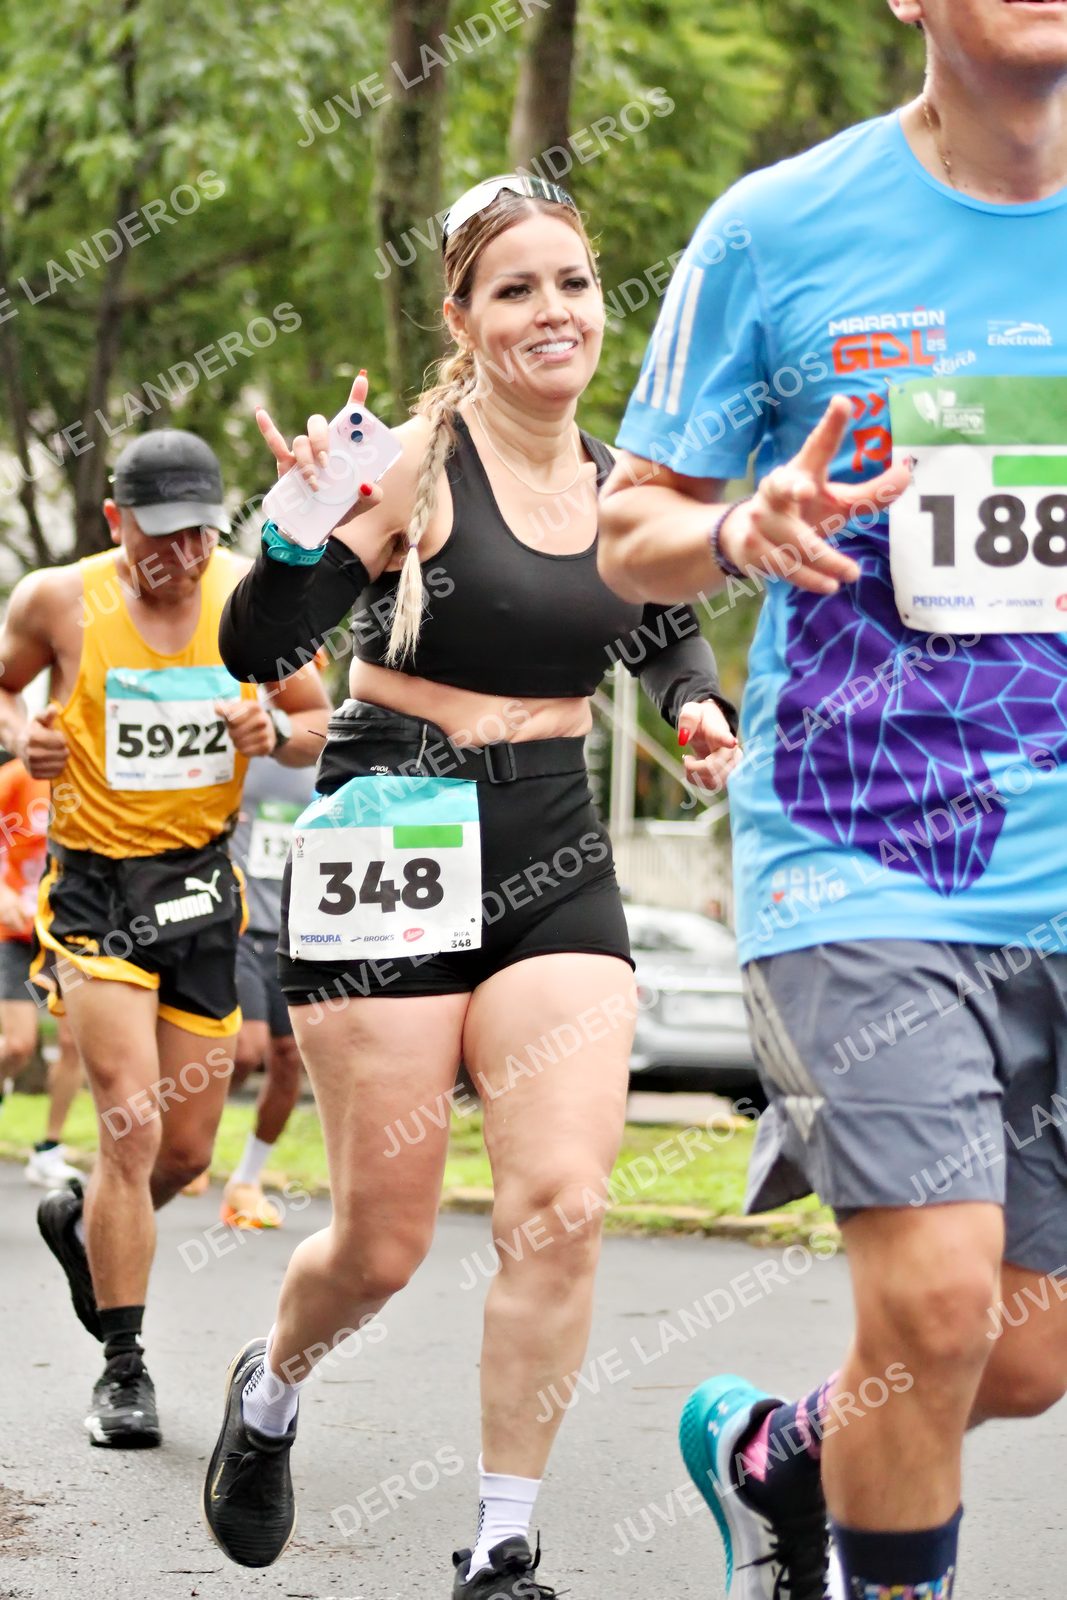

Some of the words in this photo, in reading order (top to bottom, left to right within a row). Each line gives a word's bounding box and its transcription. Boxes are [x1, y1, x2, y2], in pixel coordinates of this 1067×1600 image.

[831, 330, 936, 375] GDL
[912, 595, 976, 607] PERDURA
[116, 719, 228, 759] 5922
[317, 857, 445, 916] 348
[154, 891, 215, 927] PUMA
[300, 934, 342, 943] PERDURA
[363, 934, 395, 942] BROOKS
[450, 938, 472, 949] 348
